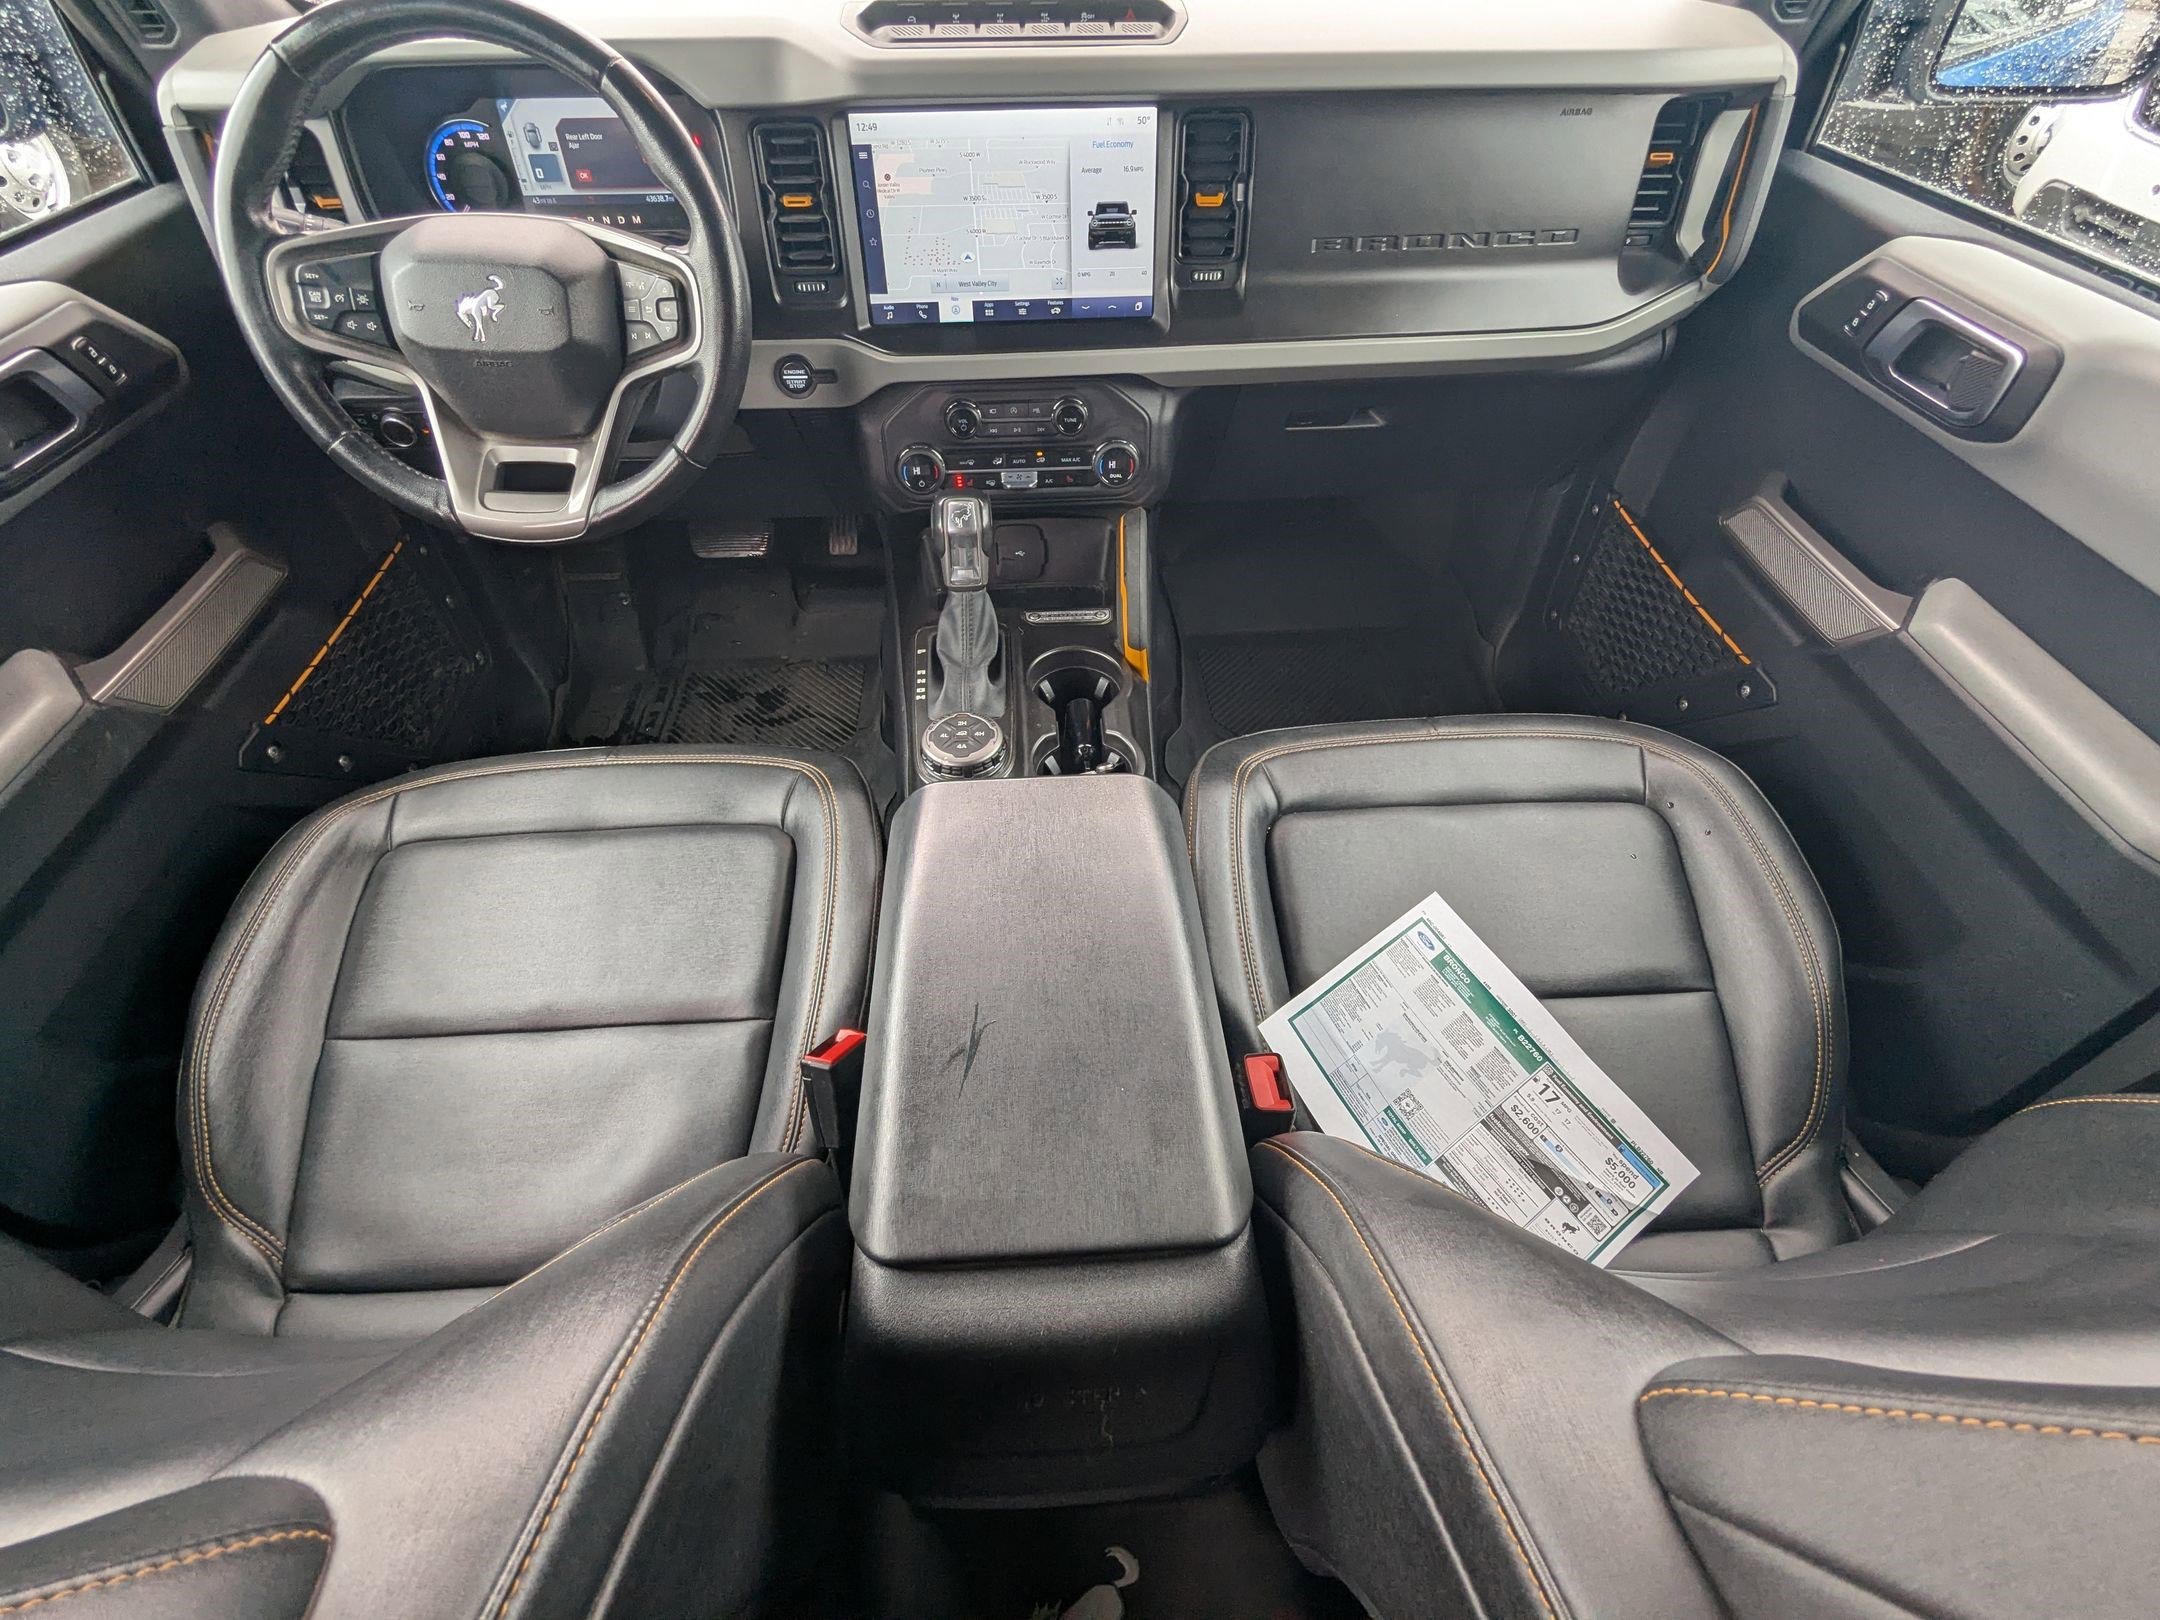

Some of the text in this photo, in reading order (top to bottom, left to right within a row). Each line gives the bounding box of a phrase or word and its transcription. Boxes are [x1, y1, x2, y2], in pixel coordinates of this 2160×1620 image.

[1559, 107, 1593, 117] AIRBAG
[856, 123, 878, 132] 12:49
[1137, 116, 1151, 125] 50°
[569, 142, 579, 150] Ajar
[1092, 140, 1133, 149] Fuel Economy
[535, 168, 544, 178] 0
[603, 216, 610, 224] N
[618, 216, 625, 224] D
[632, 216, 641, 224] M
[1311, 228, 1579, 254] BRONCO
[913, 467, 921, 475] HI
[1442, 954, 1471, 984] BRONCO
[1516, 1034, 1543, 1062] B22760
[1534, 1082, 1560, 1106] 17
[1559, 1100, 1572, 1113] MPG
[1551, 1074, 1562, 1085] Fuel
[1559, 1084, 1580, 1105] Economy
[1578, 1103, 1588, 1112] and
[1586, 1111, 1614, 1140] Environment
[1386, 1109, 1398, 1123] TOTAL
[1508, 1103, 1540, 1136] $2,600
[1563, 1118, 1571, 1126] 17
[1630, 1140, 1654, 1164] PLB22760
[1603, 1156, 1637, 1190] $5,000
[1616, 1158, 1639, 1181] spend
